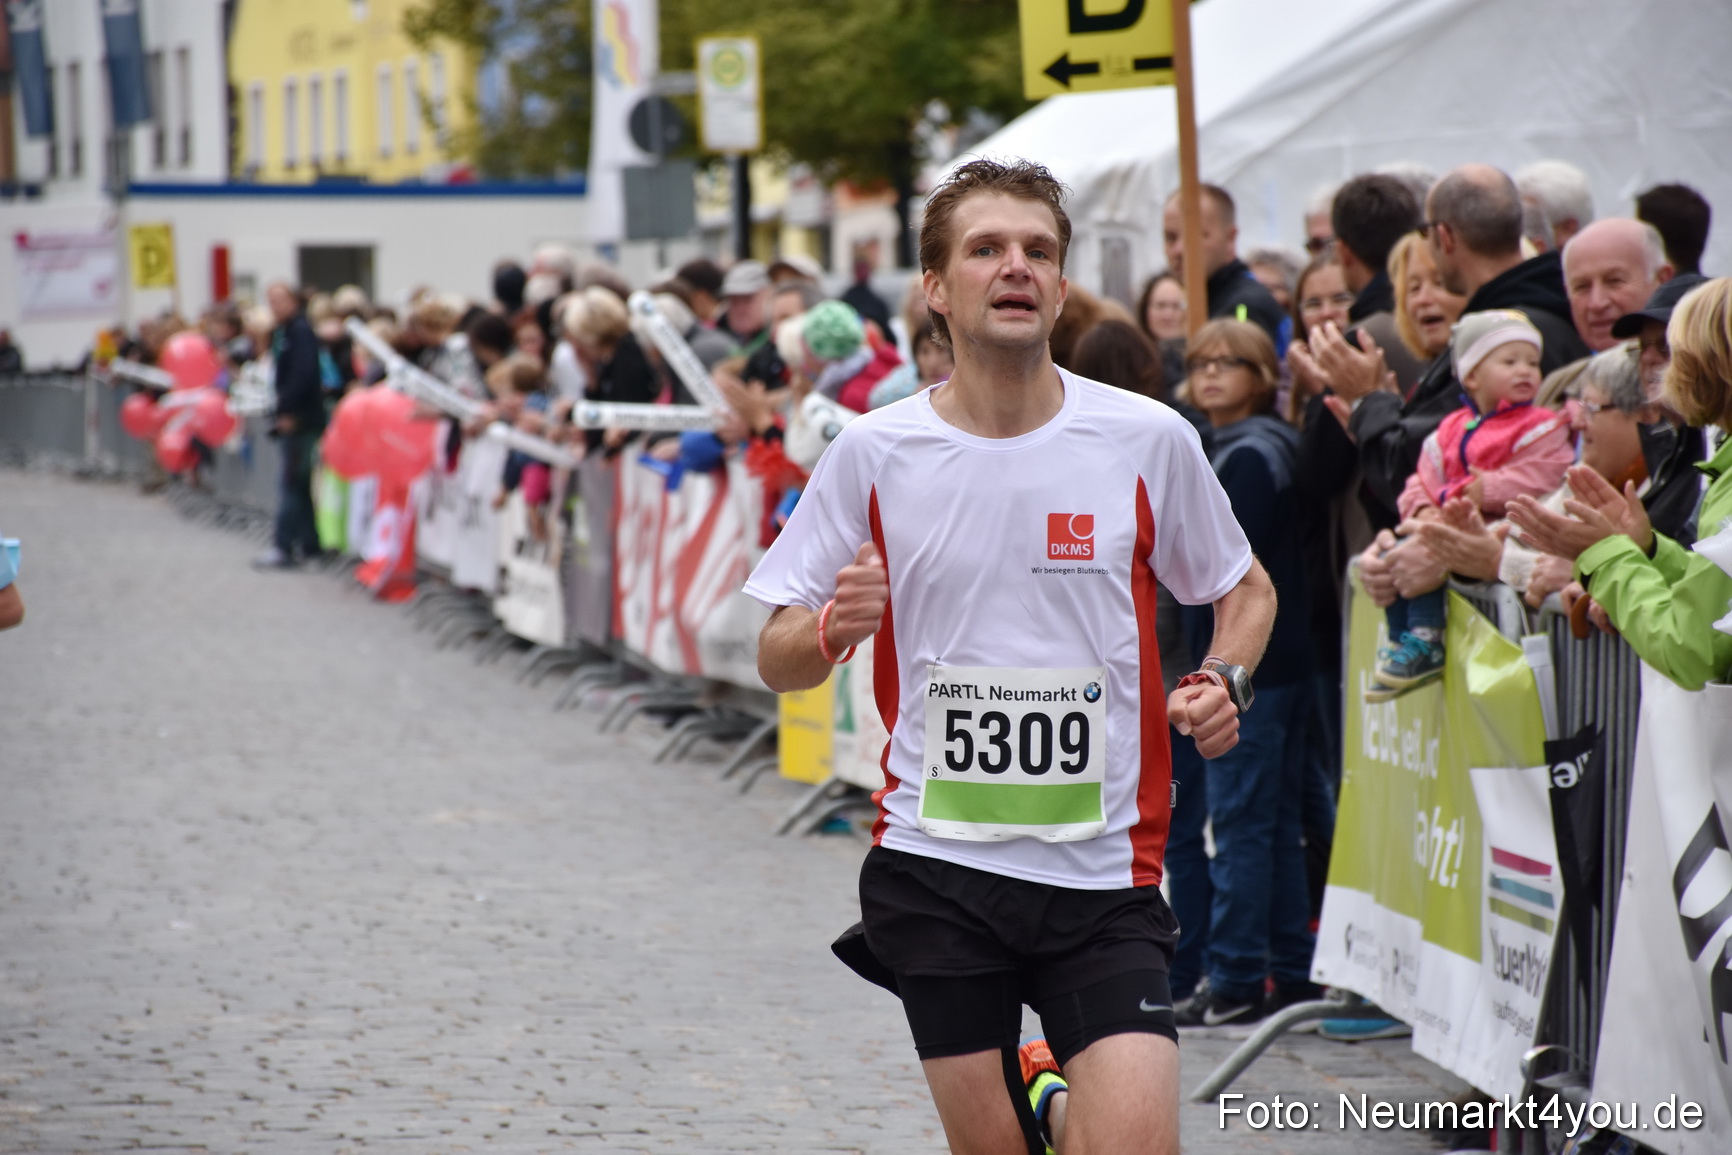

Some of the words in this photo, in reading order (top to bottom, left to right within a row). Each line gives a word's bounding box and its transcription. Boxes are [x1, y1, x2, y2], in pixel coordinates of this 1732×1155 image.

[1051, 543, 1091, 556] DKMS
[1044, 567, 1076, 575] besiegen
[928, 682, 984, 700] PARTL
[989, 685, 1077, 702] Neumarkt
[944, 709, 1090, 776] 5309
[931, 766, 938, 777] S
